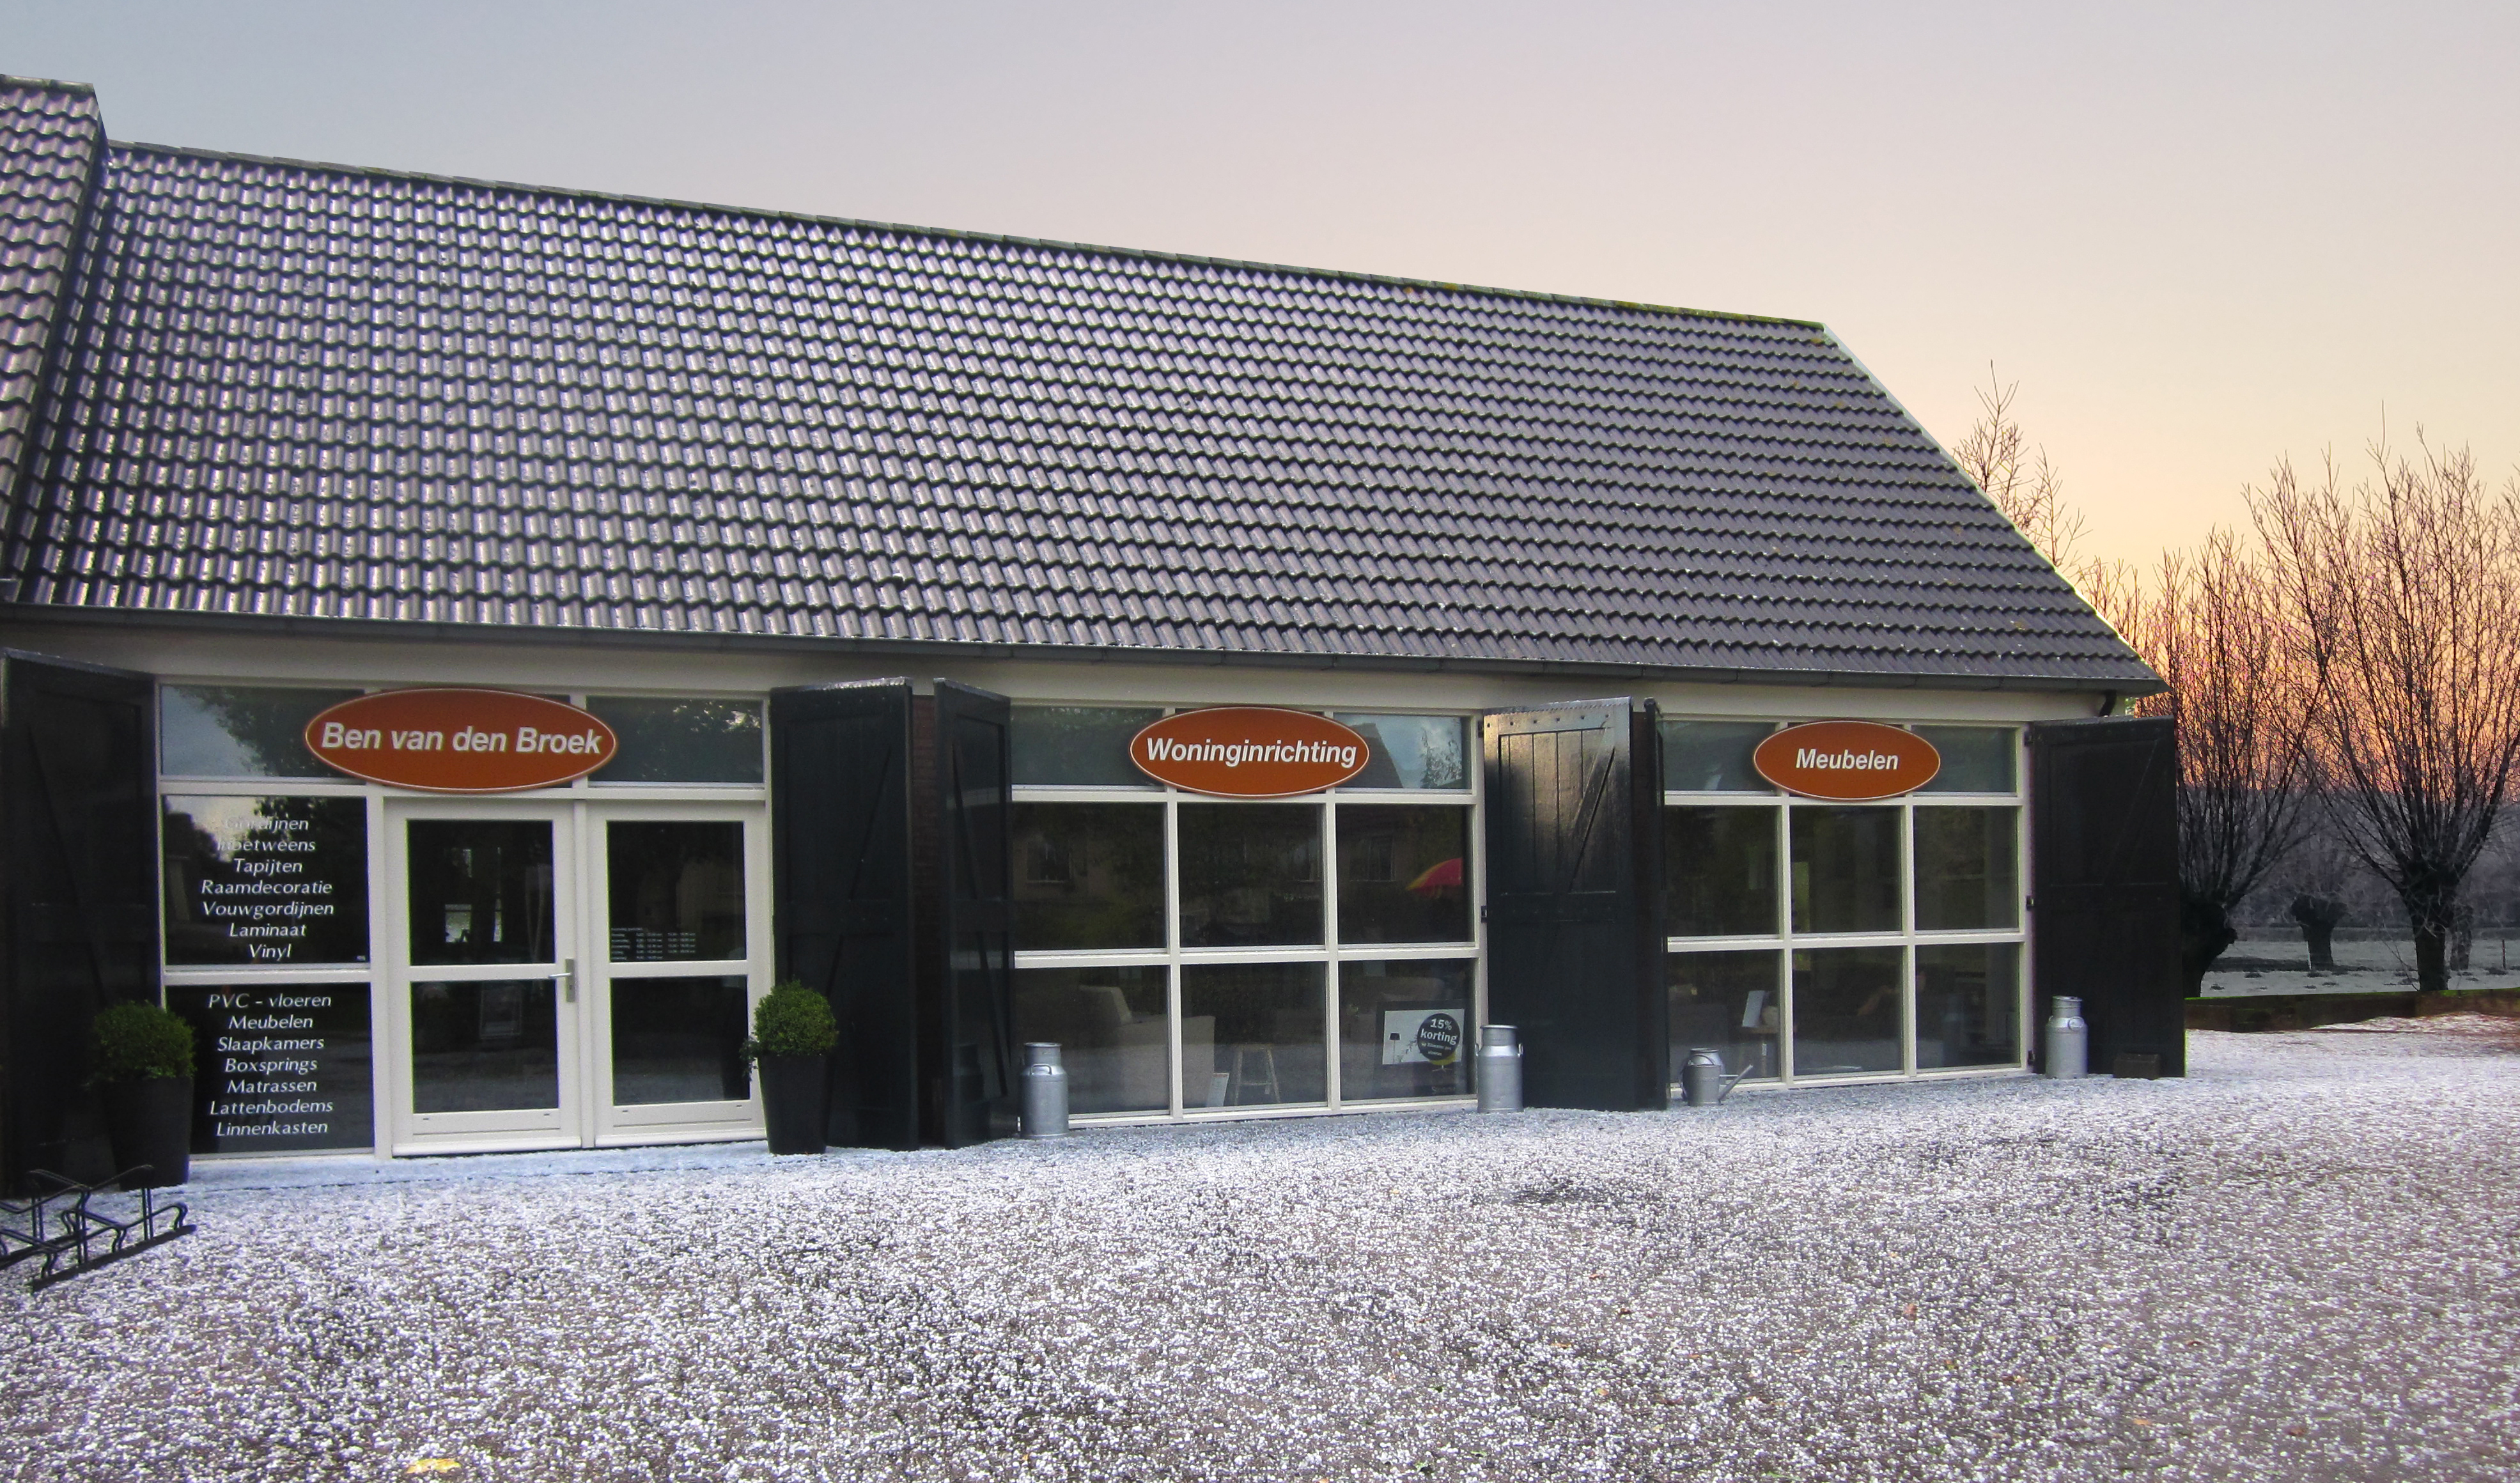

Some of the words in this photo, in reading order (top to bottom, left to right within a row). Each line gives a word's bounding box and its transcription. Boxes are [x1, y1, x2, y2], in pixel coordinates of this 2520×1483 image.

[321, 721, 381, 749] Ben
[391, 729, 444, 750] van
[452, 725, 508, 752] den
[515, 726, 602, 754] Broek
[1147, 737, 1357, 768] Woninginrichting
[1795, 748, 1899, 770] Meubelen
[233, 858, 303, 876] Tapijten
[201, 880, 333, 895] Raamdecoratie
[203, 901, 334, 919] Vouwgordijnen
[229, 922, 307, 937] Laminaat
[249, 943, 292, 961] Vinyl
[208, 993, 251, 1008] PVC
[268, 993, 332, 1007] vloeren
[228, 1014, 314, 1030] Meubelen
[1430, 1018, 1452, 1030] 15%
[1420, 1028, 1458, 1045] korting
[217, 1036, 325, 1055] Slaapkamers
[224, 1057, 318, 1075] Boxsprings
[226, 1079, 318, 1094] Matrassen
[210, 1099, 334, 1115] Lattenbodems
[215, 1121, 329, 1137] Linnenkasten
